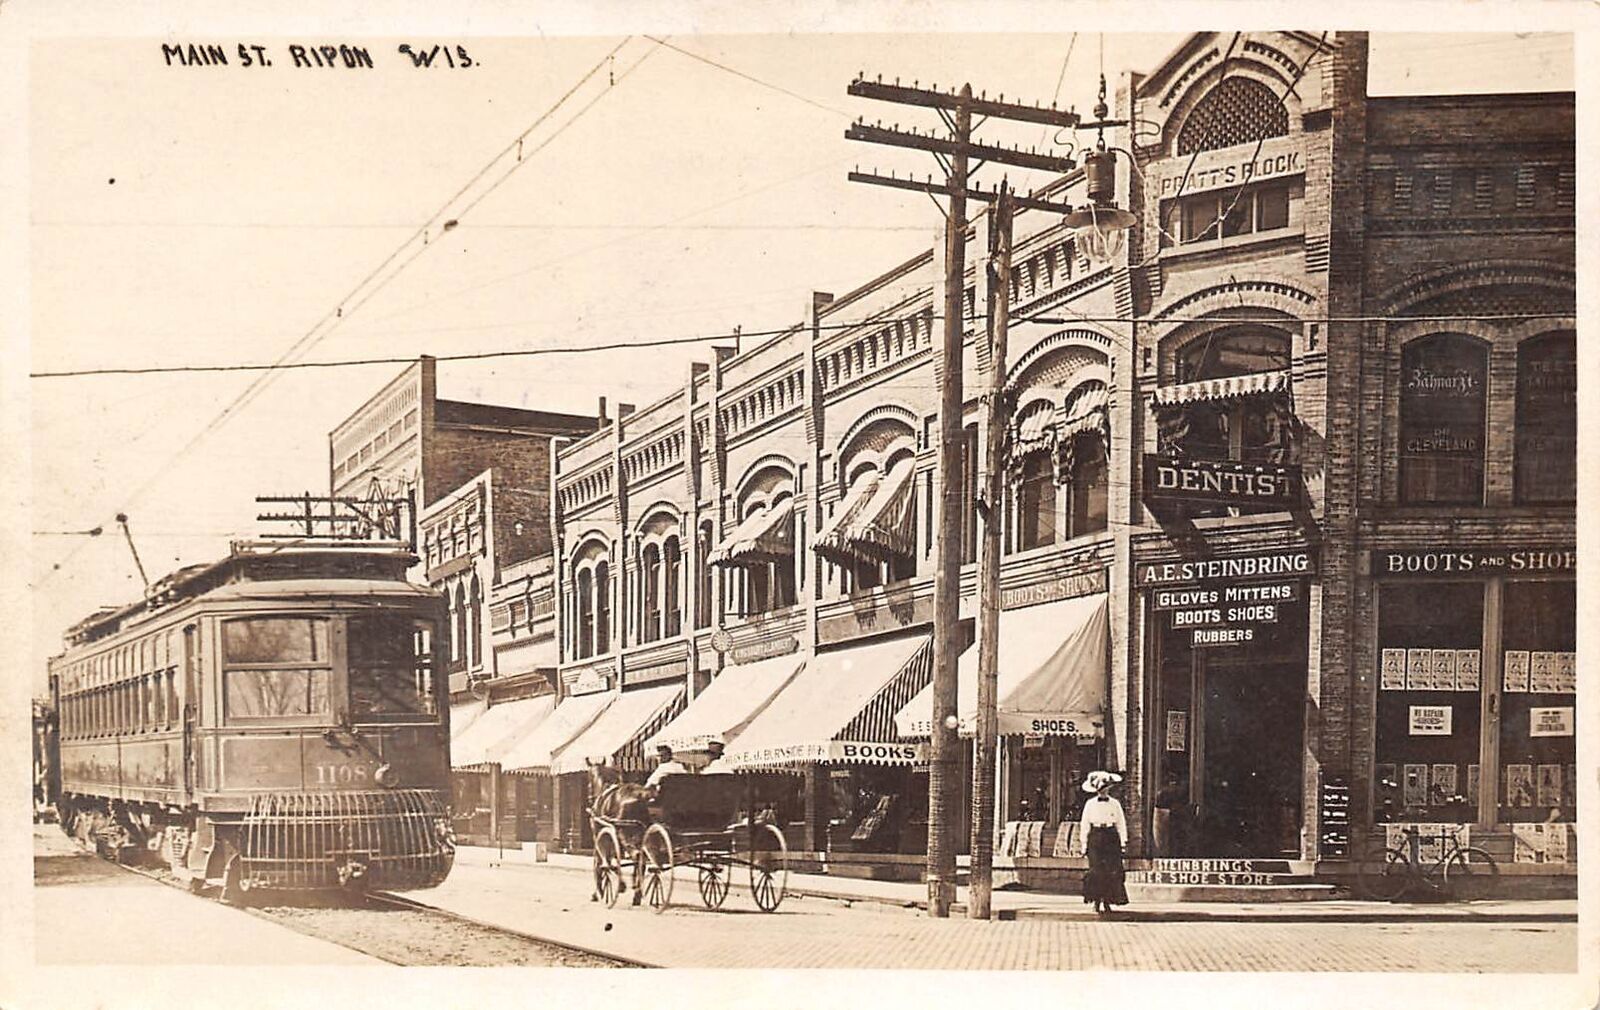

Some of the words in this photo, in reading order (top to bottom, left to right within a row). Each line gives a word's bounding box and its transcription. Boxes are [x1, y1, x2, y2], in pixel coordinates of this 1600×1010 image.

[1161, 165, 1236, 196] PRATT'S
[1156, 466, 1290, 497] DENTIST
[1387, 553, 1474, 573] BOOTS
[1479, 556, 1505, 567] AND
[1159, 590, 1219, 607] GLOVES
[1225, 585, 1292, 602] MITTENS
[1175, 609, 1221, 625] BOOTS
[1227, 605, 1275, 621] SHOES
[1193, 629, 1254, 644] RUBBERS
[1031, 719, 1080, 733] SHOES.
[843, 744, 916, 759] BOOKS
[316, 765, 368, 784] 1108
[1169, 872, 1209, 884] SHOE
[1217, 873, 1275, 886] STORE
